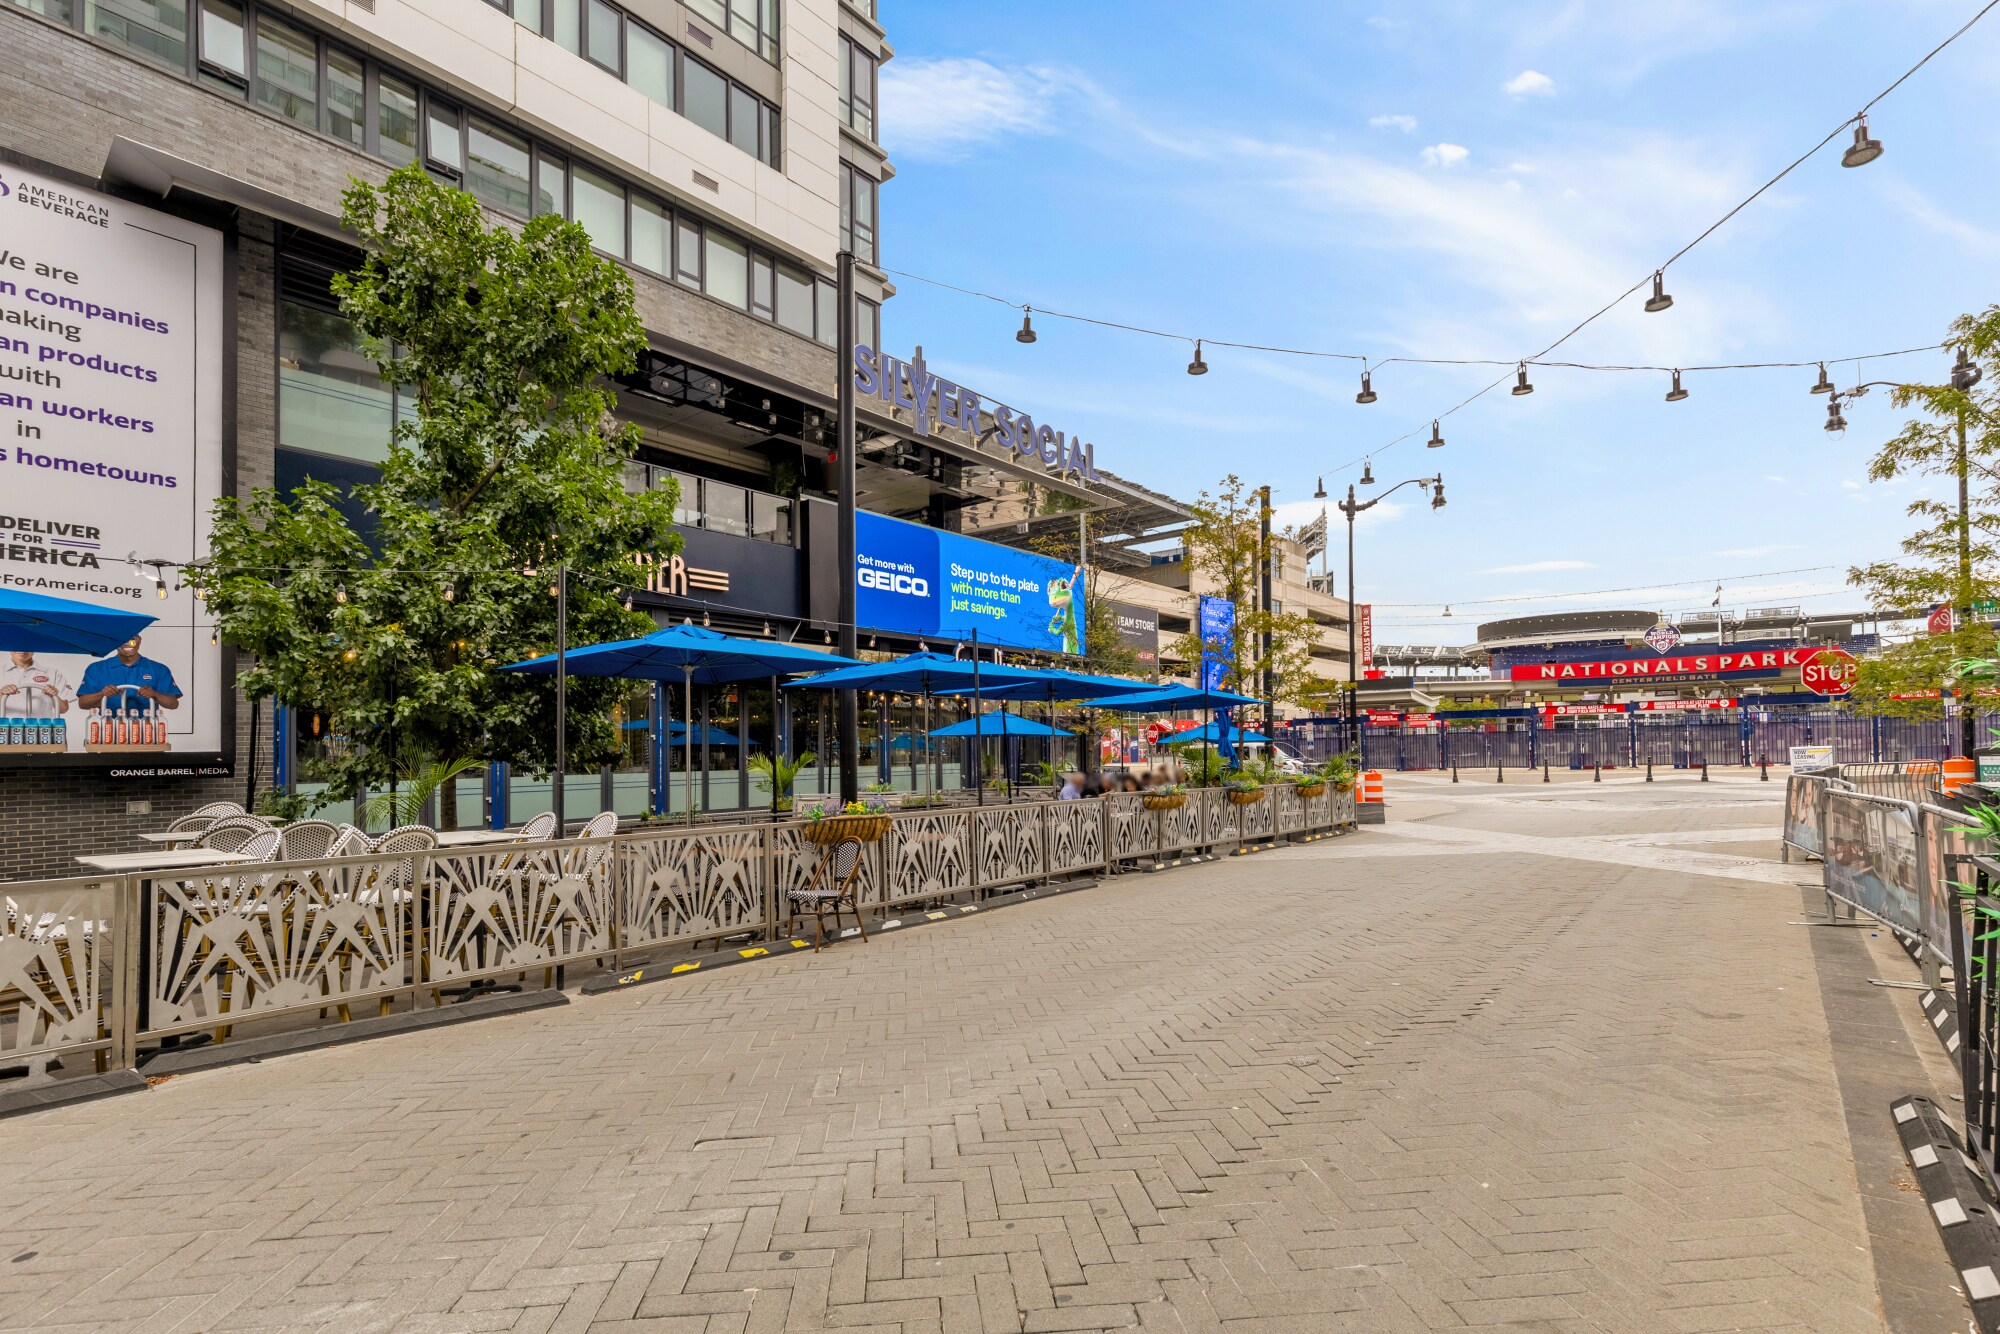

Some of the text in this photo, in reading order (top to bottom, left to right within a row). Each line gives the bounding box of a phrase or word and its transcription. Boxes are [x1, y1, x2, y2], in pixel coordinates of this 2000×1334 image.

[18, 182, 109, 217] AMERICAN
[18, 193, 109, 228] BEVERAGE
[35, 262, 79, 285] are
[24, 287, 169, 334] companies
[38, 345, 158, 383] products
[0, 365, 61, 389] with
[42, 401, 154, 433] workers
[855, 344, 1100, 481] SILVER SOCIAL
[17, 420, 41, 440] in
[16, 447, 177, 488] hometowns
[0, 515, 100, 540] DELIVER
[13, 532, 43, 544] FOR
[857, 554, 914, 573] Get more with
[0, 574, 142, 598] ForAmerica.org
[857, 567, 928, 597] GEICO
[951, 563, 1039, 593] Step up to the plate
[951, 581, 1020, 605] with more than
[951, 596, 1007, 620] just savings.
[1117, 616, 1154, 631] TEAM STORE
[1541, 651, 1800, 678] NATIONALS PARK
[1805, 663, 1857, 682] STOP
[1656, 675, 1686, 683] FIELD
[1689, 673, 1718, 681] GATE
[12, 727, 21, 745] core
[27, 727, 35, 745] core
[41, 727, 49, 745] core
[55, 727, 63, 745] core
[110, 766, 229, 778] ORANGE BARREL MEDIA
